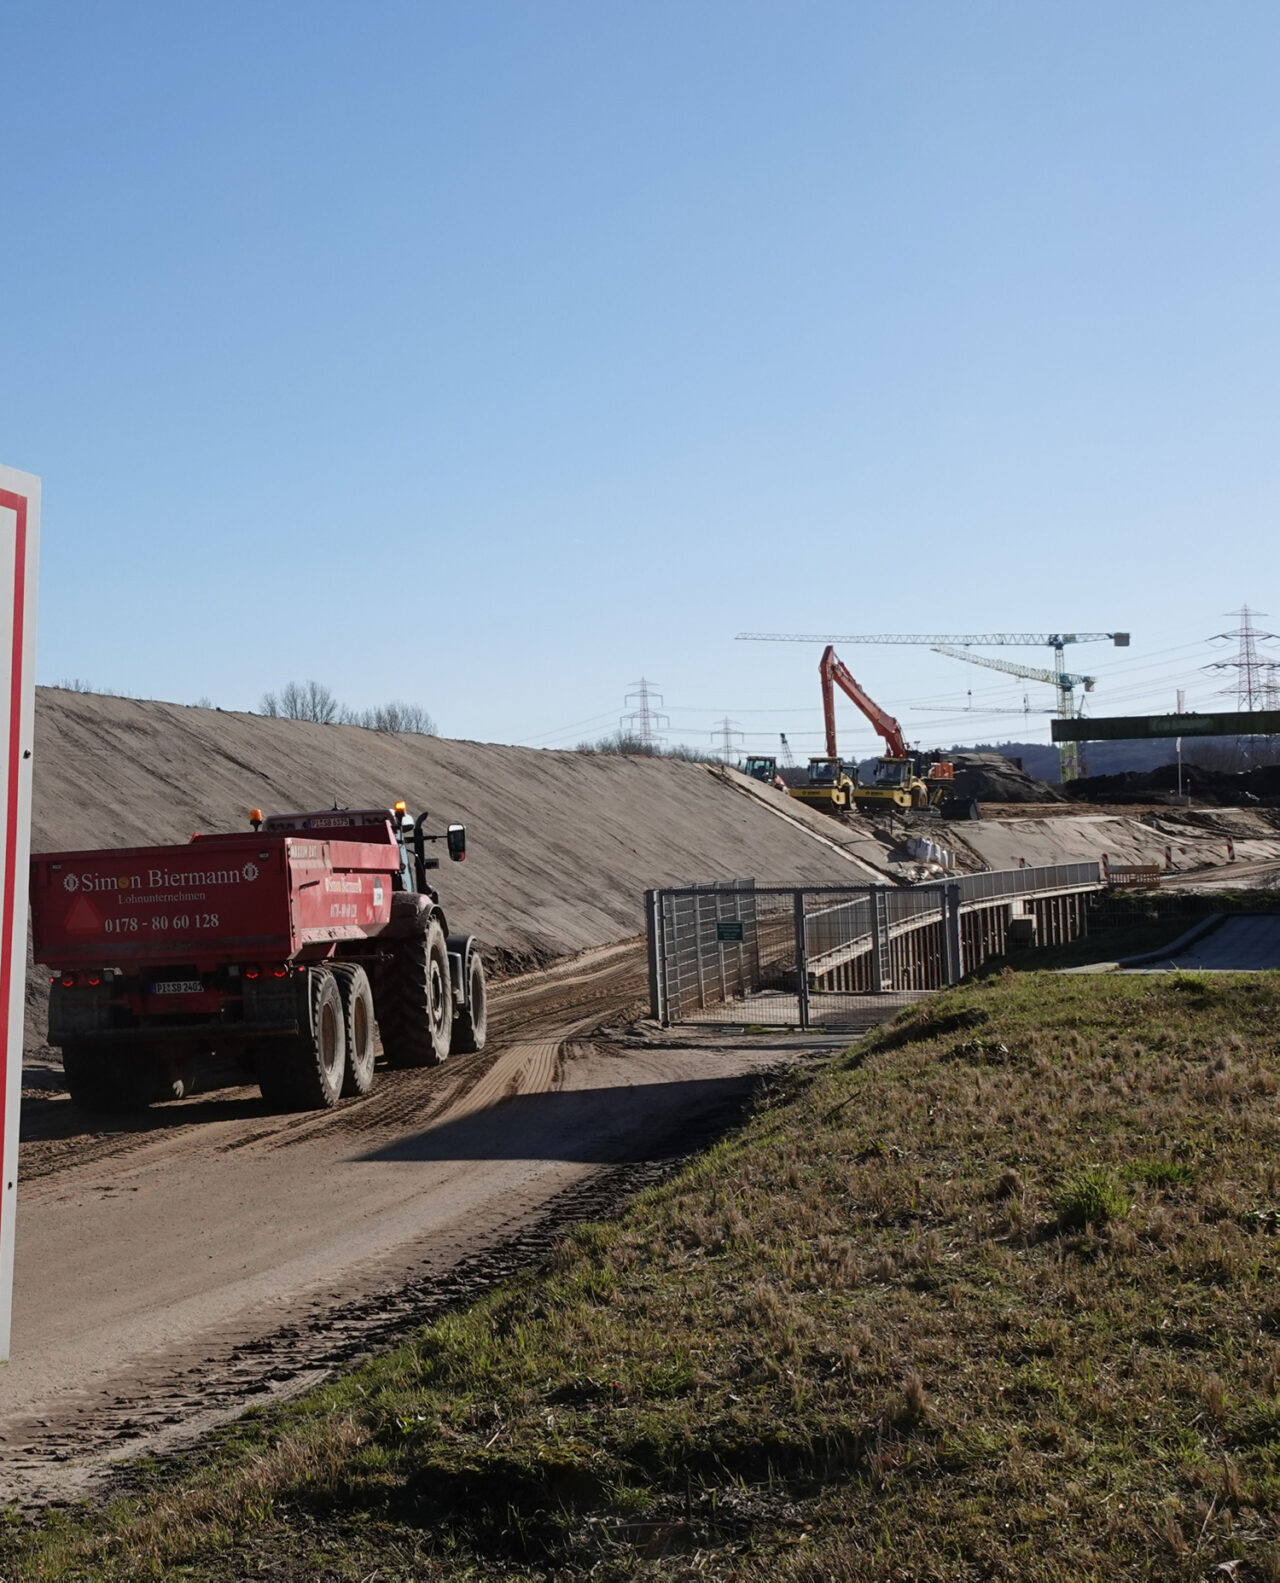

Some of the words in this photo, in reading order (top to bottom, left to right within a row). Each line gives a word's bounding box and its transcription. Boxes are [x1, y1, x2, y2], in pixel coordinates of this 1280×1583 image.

[81, 873, 141, 891] Simon
[148, 868, 240, 888] Biermann
[118, 892, 206, 905] Lohnunternehmen
[105, 917, 138, 933] 0178
[152, 916, 168, 930] 80
[173, 915, 190, 929] 60
[195, 913, 219, 928] 128
